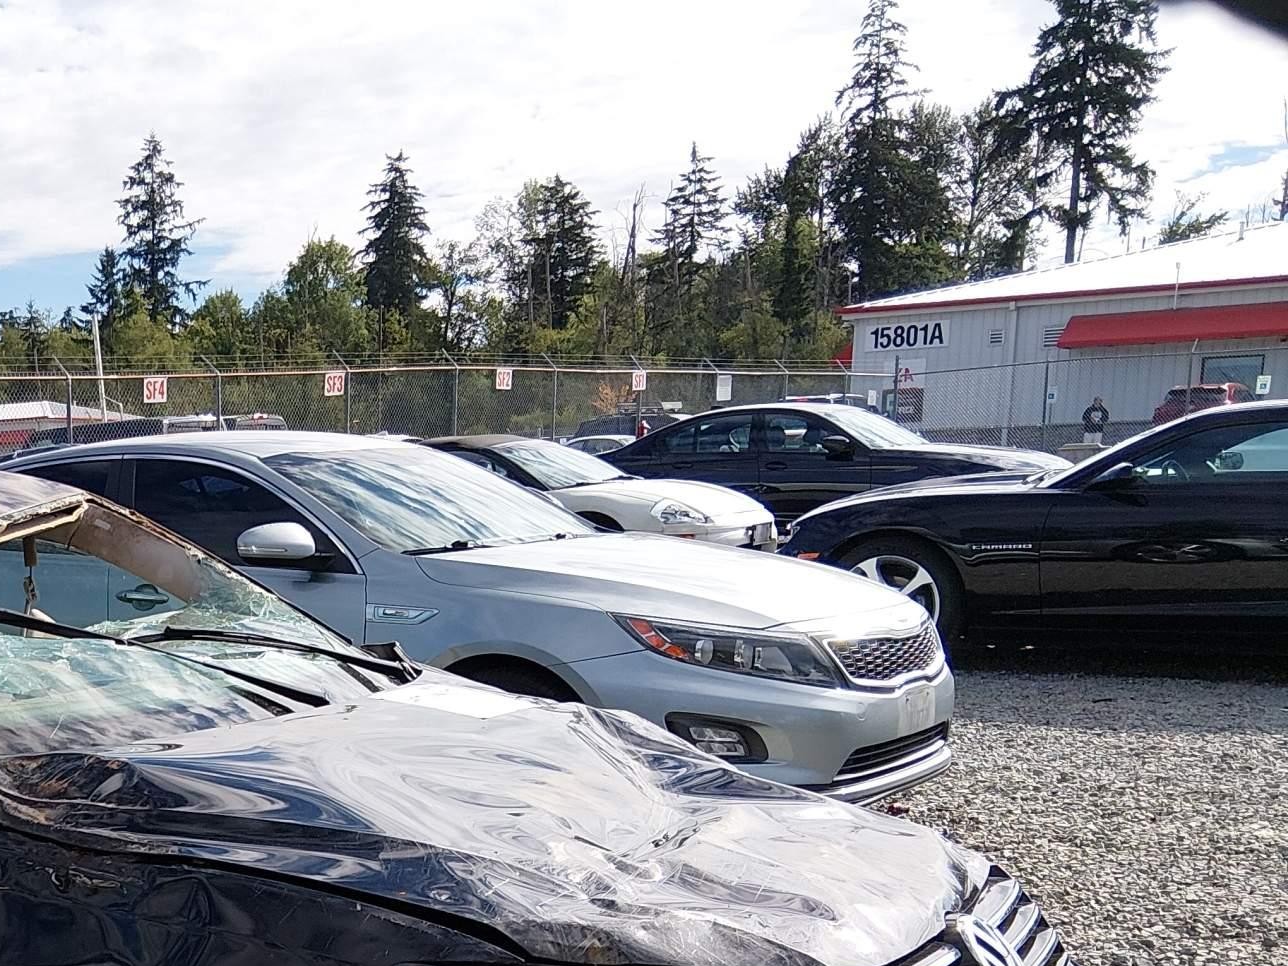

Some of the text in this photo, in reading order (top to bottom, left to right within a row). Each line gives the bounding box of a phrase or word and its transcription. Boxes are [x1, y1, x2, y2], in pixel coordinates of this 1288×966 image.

[870, 322, 944, 349] 15801A
[326, 375, 343, 393] SF3
[498, 371, 511, 387] SF2
[145, 380, 165, 400] SF4
